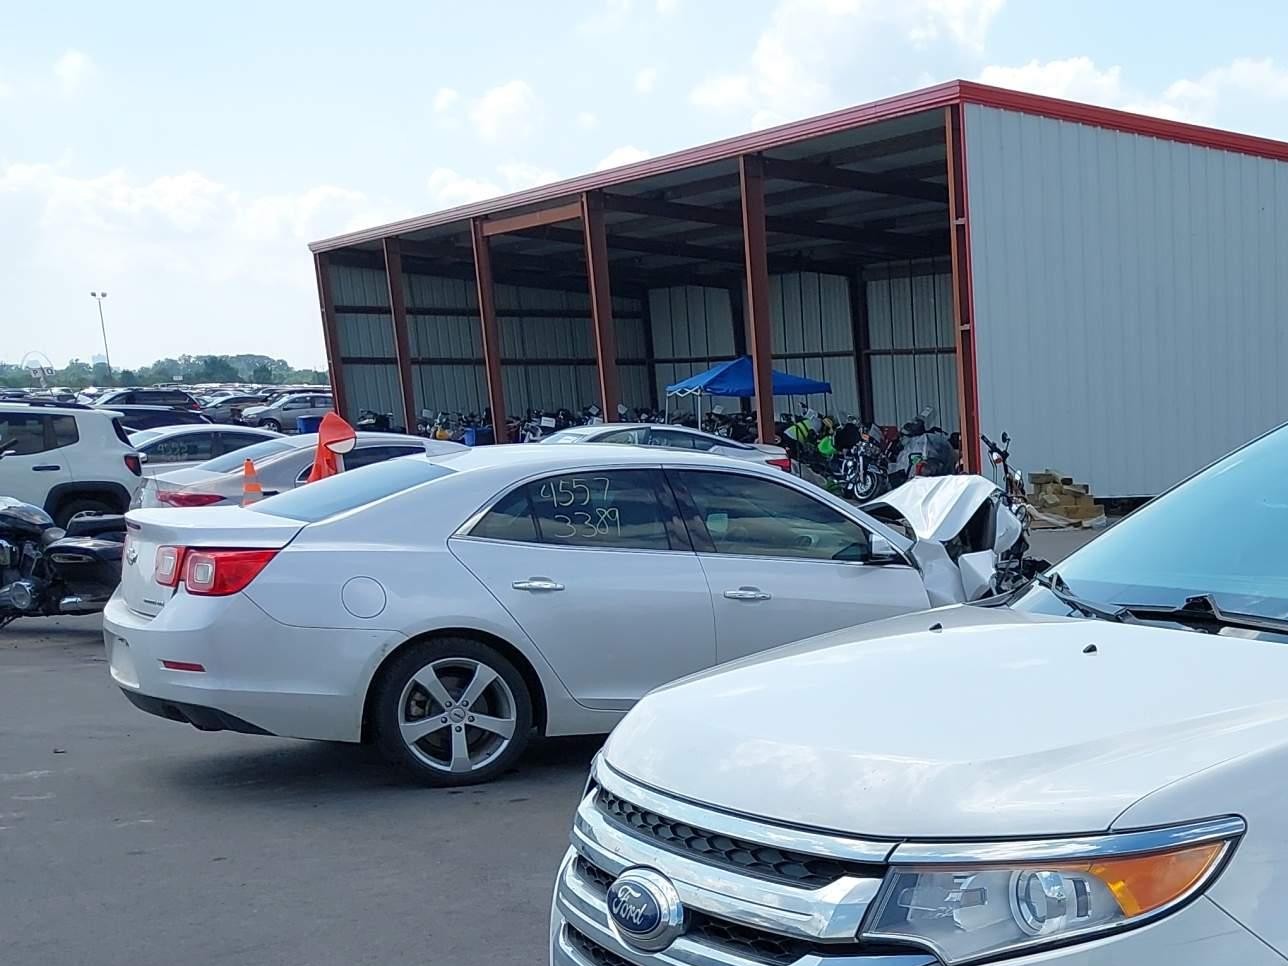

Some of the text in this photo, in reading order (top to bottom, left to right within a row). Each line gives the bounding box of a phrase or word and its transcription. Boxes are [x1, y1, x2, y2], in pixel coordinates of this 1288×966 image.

[540, 477, 610, 508] 4557
[554, 507, 621, 538] 3389
[612, 885, 647, 925] Ford
